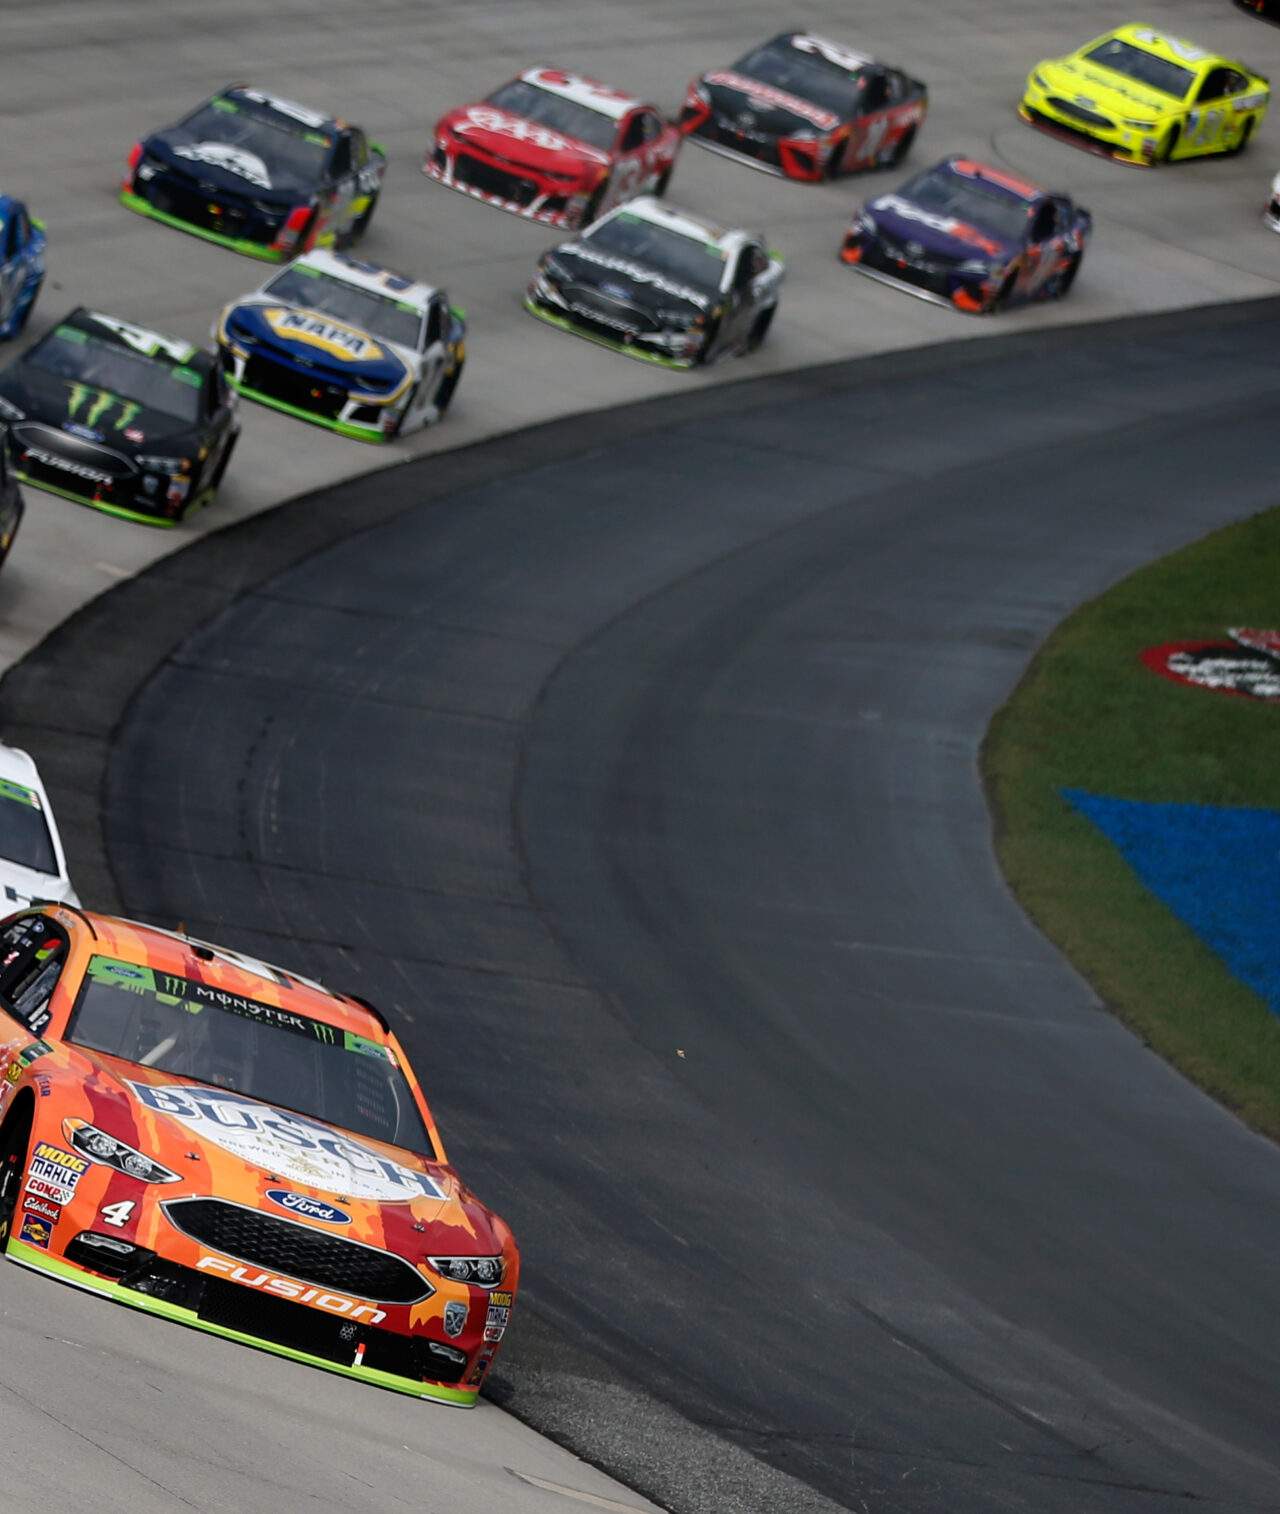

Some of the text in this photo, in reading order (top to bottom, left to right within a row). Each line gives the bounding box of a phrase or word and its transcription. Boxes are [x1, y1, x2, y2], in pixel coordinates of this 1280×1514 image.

[283, 313, 367, 353] NAPA
[196, 985, 305, 1030] MONSTER
[133, 1083, 442, 1199] BUSCH
[218, 1137, 281, 1158] BREWED
[34, 1144, 89, 1172] MOOG
[28, 1178, 61, 1196] COMP
[30, 1158, 79, 1188] MAHLE
[23, 1196, 60, 1221] Edelbrock
[100, 1199, 138, 1228] 4
[281, 1191, 335, 1221] Ford
[194, 1256, 388, 1325] FUSION
[489, 1291, 512, 1307] MOOG
